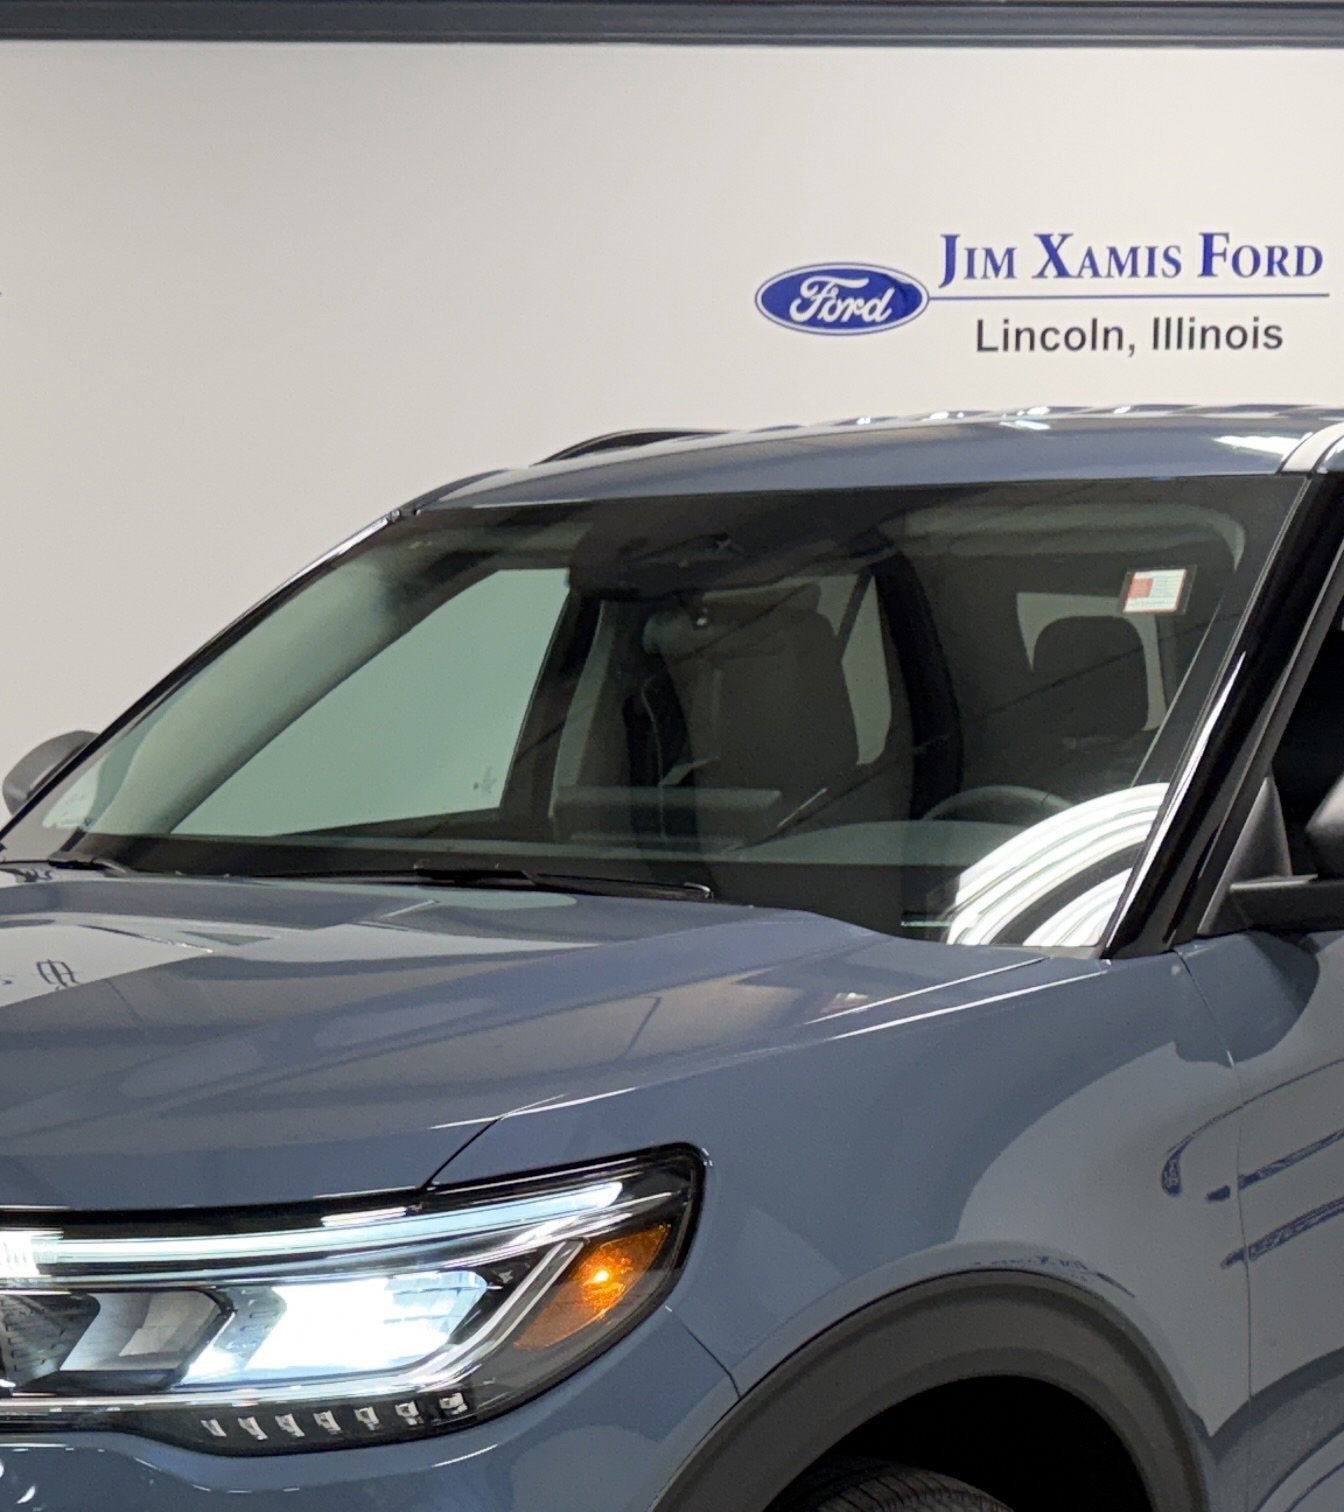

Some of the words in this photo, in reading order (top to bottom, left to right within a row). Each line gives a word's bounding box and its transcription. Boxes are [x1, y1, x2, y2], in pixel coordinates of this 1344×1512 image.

[939, 233, 1016, 288] JIM
[1033, 232, 1183, 279] XAMIS
[1197, 232, 1323, 278] FORD
[788, 274, 894, 325] Ford
[976, 317, 1136, 357] Lincoln,
[1153, 316, 1283, 350] Illinois
